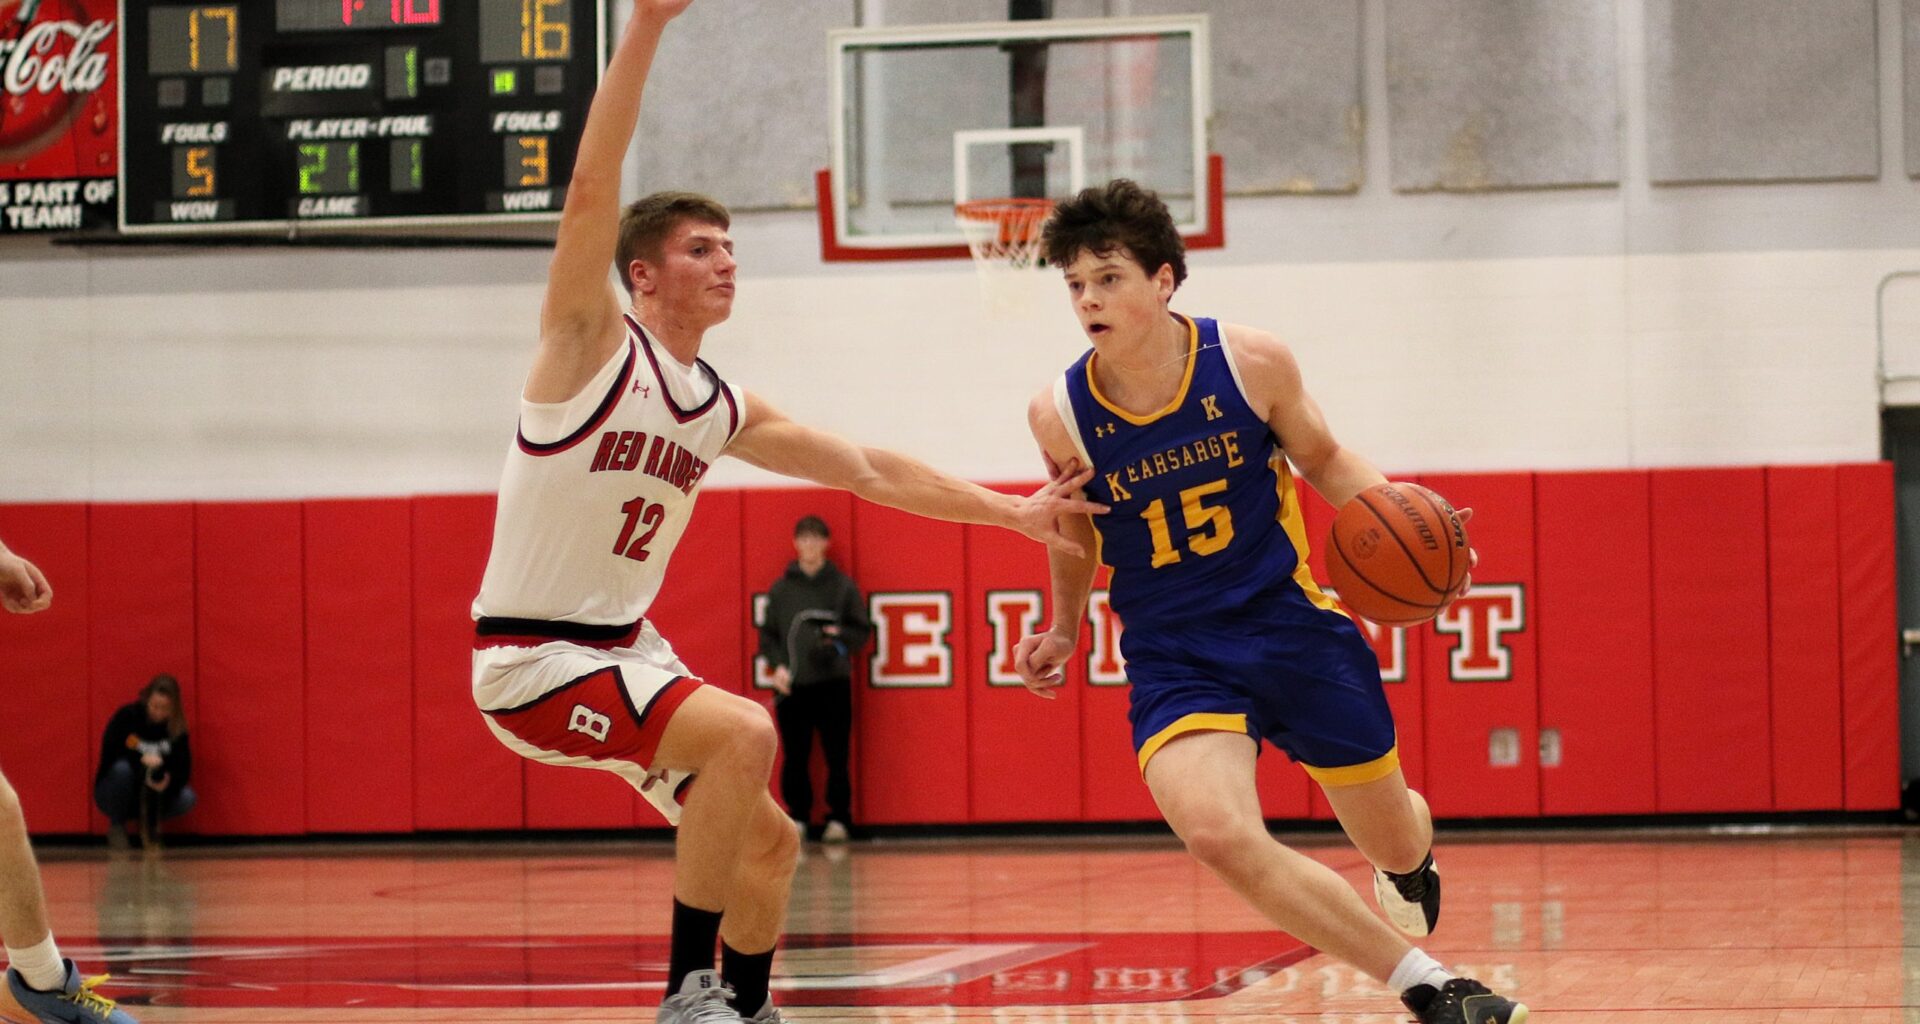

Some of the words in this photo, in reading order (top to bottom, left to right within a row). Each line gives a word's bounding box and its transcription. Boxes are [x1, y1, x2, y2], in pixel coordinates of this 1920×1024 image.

[189, 8, 237, 71] 17
[520, 0, 570, 59] 16
[273, 65, 371, 91] PERIOD
[405, 48, 417, 98] 1
[161, 122, 229, 144] FOULS
[493, 111, 562, 132] FOULS
[186, 148, 215, 196] 5
[519, 136, 549, 186] 3
[15, 182, 79, 203] PART
[83, 180, 115, 203] OF
[170, 203, 219, 220] WON
[298, 197, 359, 216] GAME
[502, 191, 552, 210] WON
[5, 204, 82, 229] TEAM!
[1201, 394, 1223, 421] K
[589, 431, 647, 473] RED
[1105, 431, 1244, 502] KEARSARGE
[612, 496, 665, 562] 12
[1139, 478, 1234, 569] 15
[567, 703, 612, 744] B
